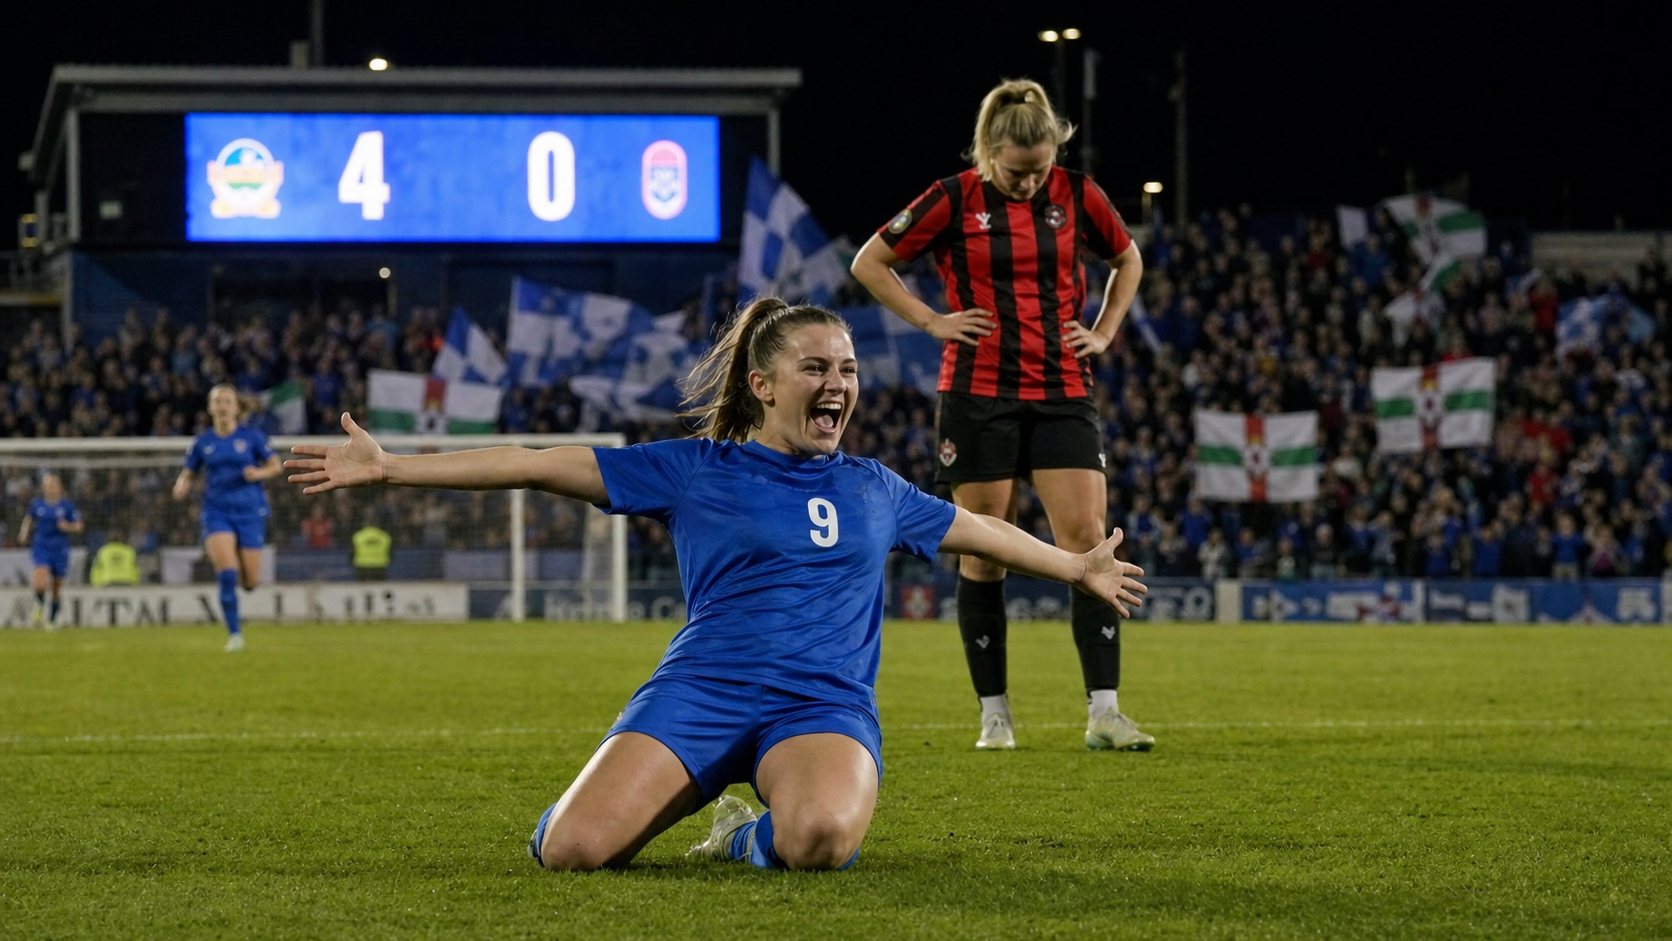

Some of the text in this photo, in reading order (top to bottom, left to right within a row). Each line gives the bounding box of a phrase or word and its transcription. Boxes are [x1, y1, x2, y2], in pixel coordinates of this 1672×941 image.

[338, 130, 575, 221] 4 0
[807, 497, 839, 548] 9
